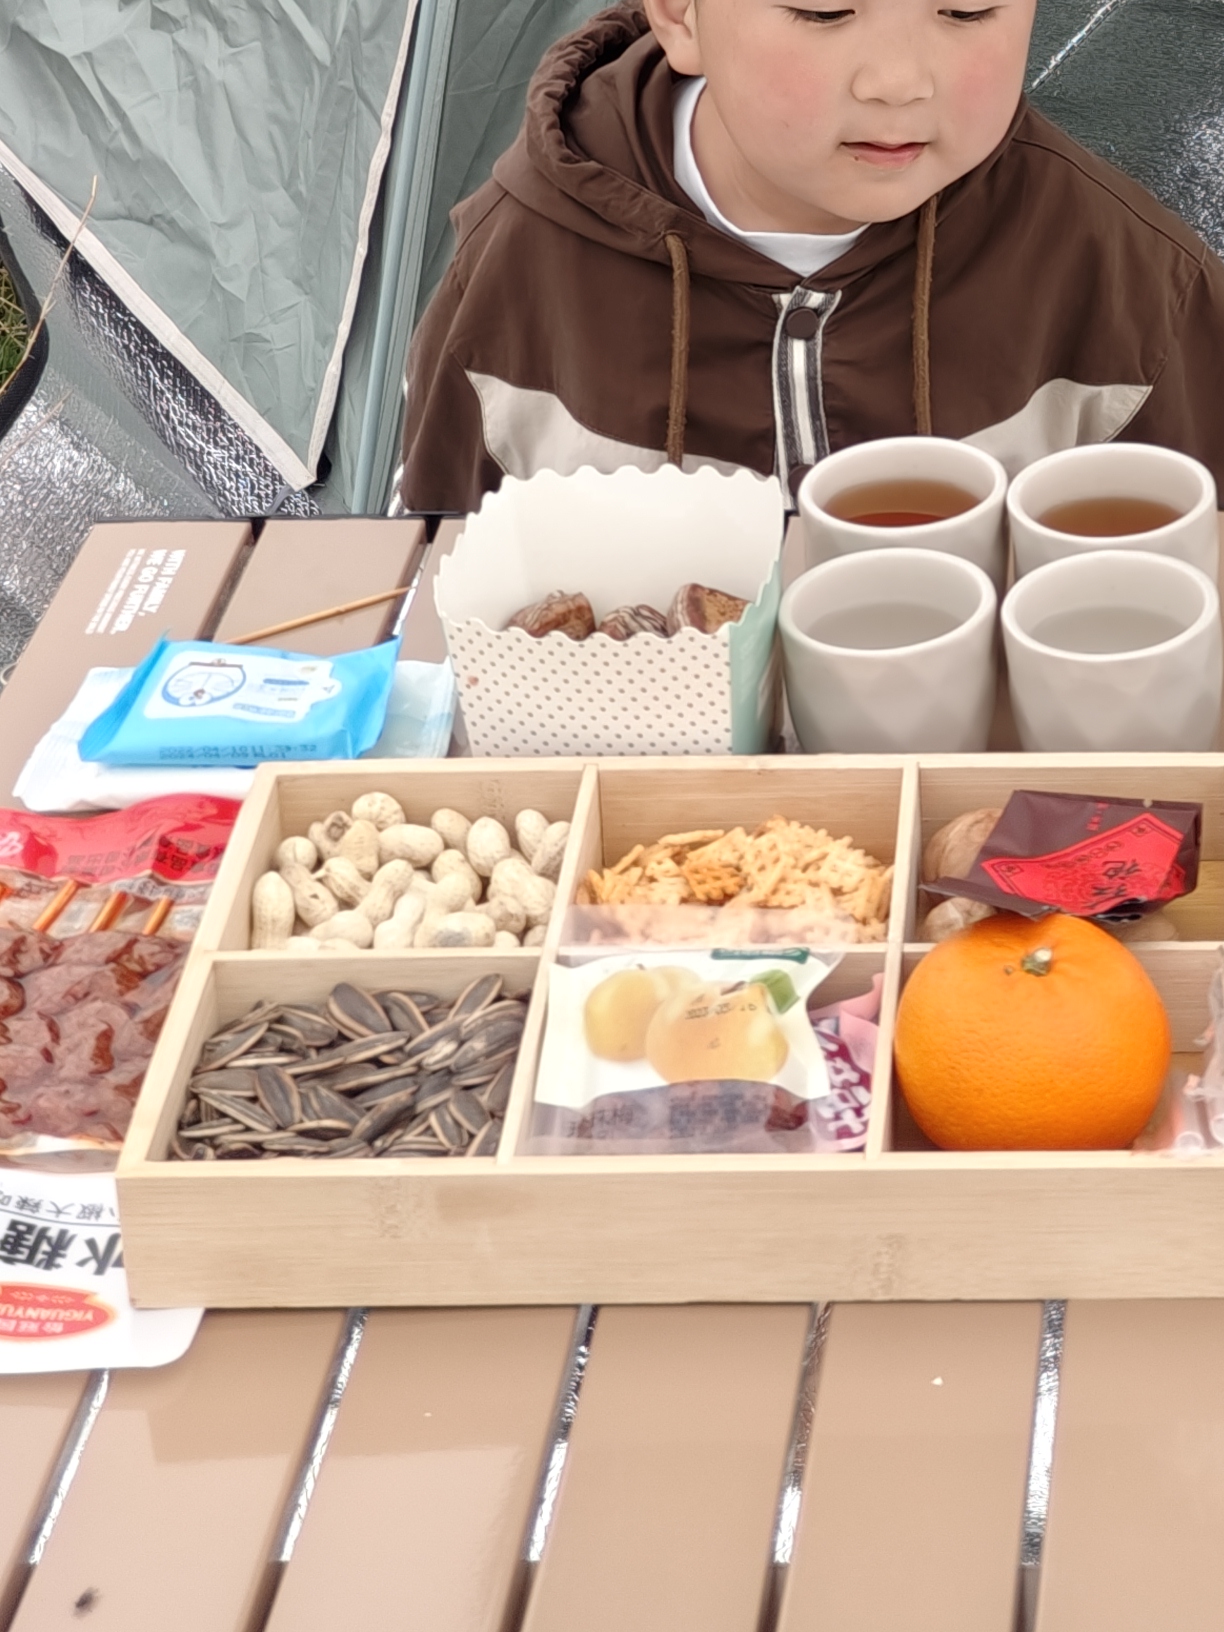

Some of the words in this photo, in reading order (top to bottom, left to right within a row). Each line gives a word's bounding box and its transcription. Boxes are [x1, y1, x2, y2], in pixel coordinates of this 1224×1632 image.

[146, 548, 168, 566] WE
[161, 549, 187, 575] WITH
[138, 566, 158, 582] GO
[0, 1302, 95, 1322] YIGUANYU
